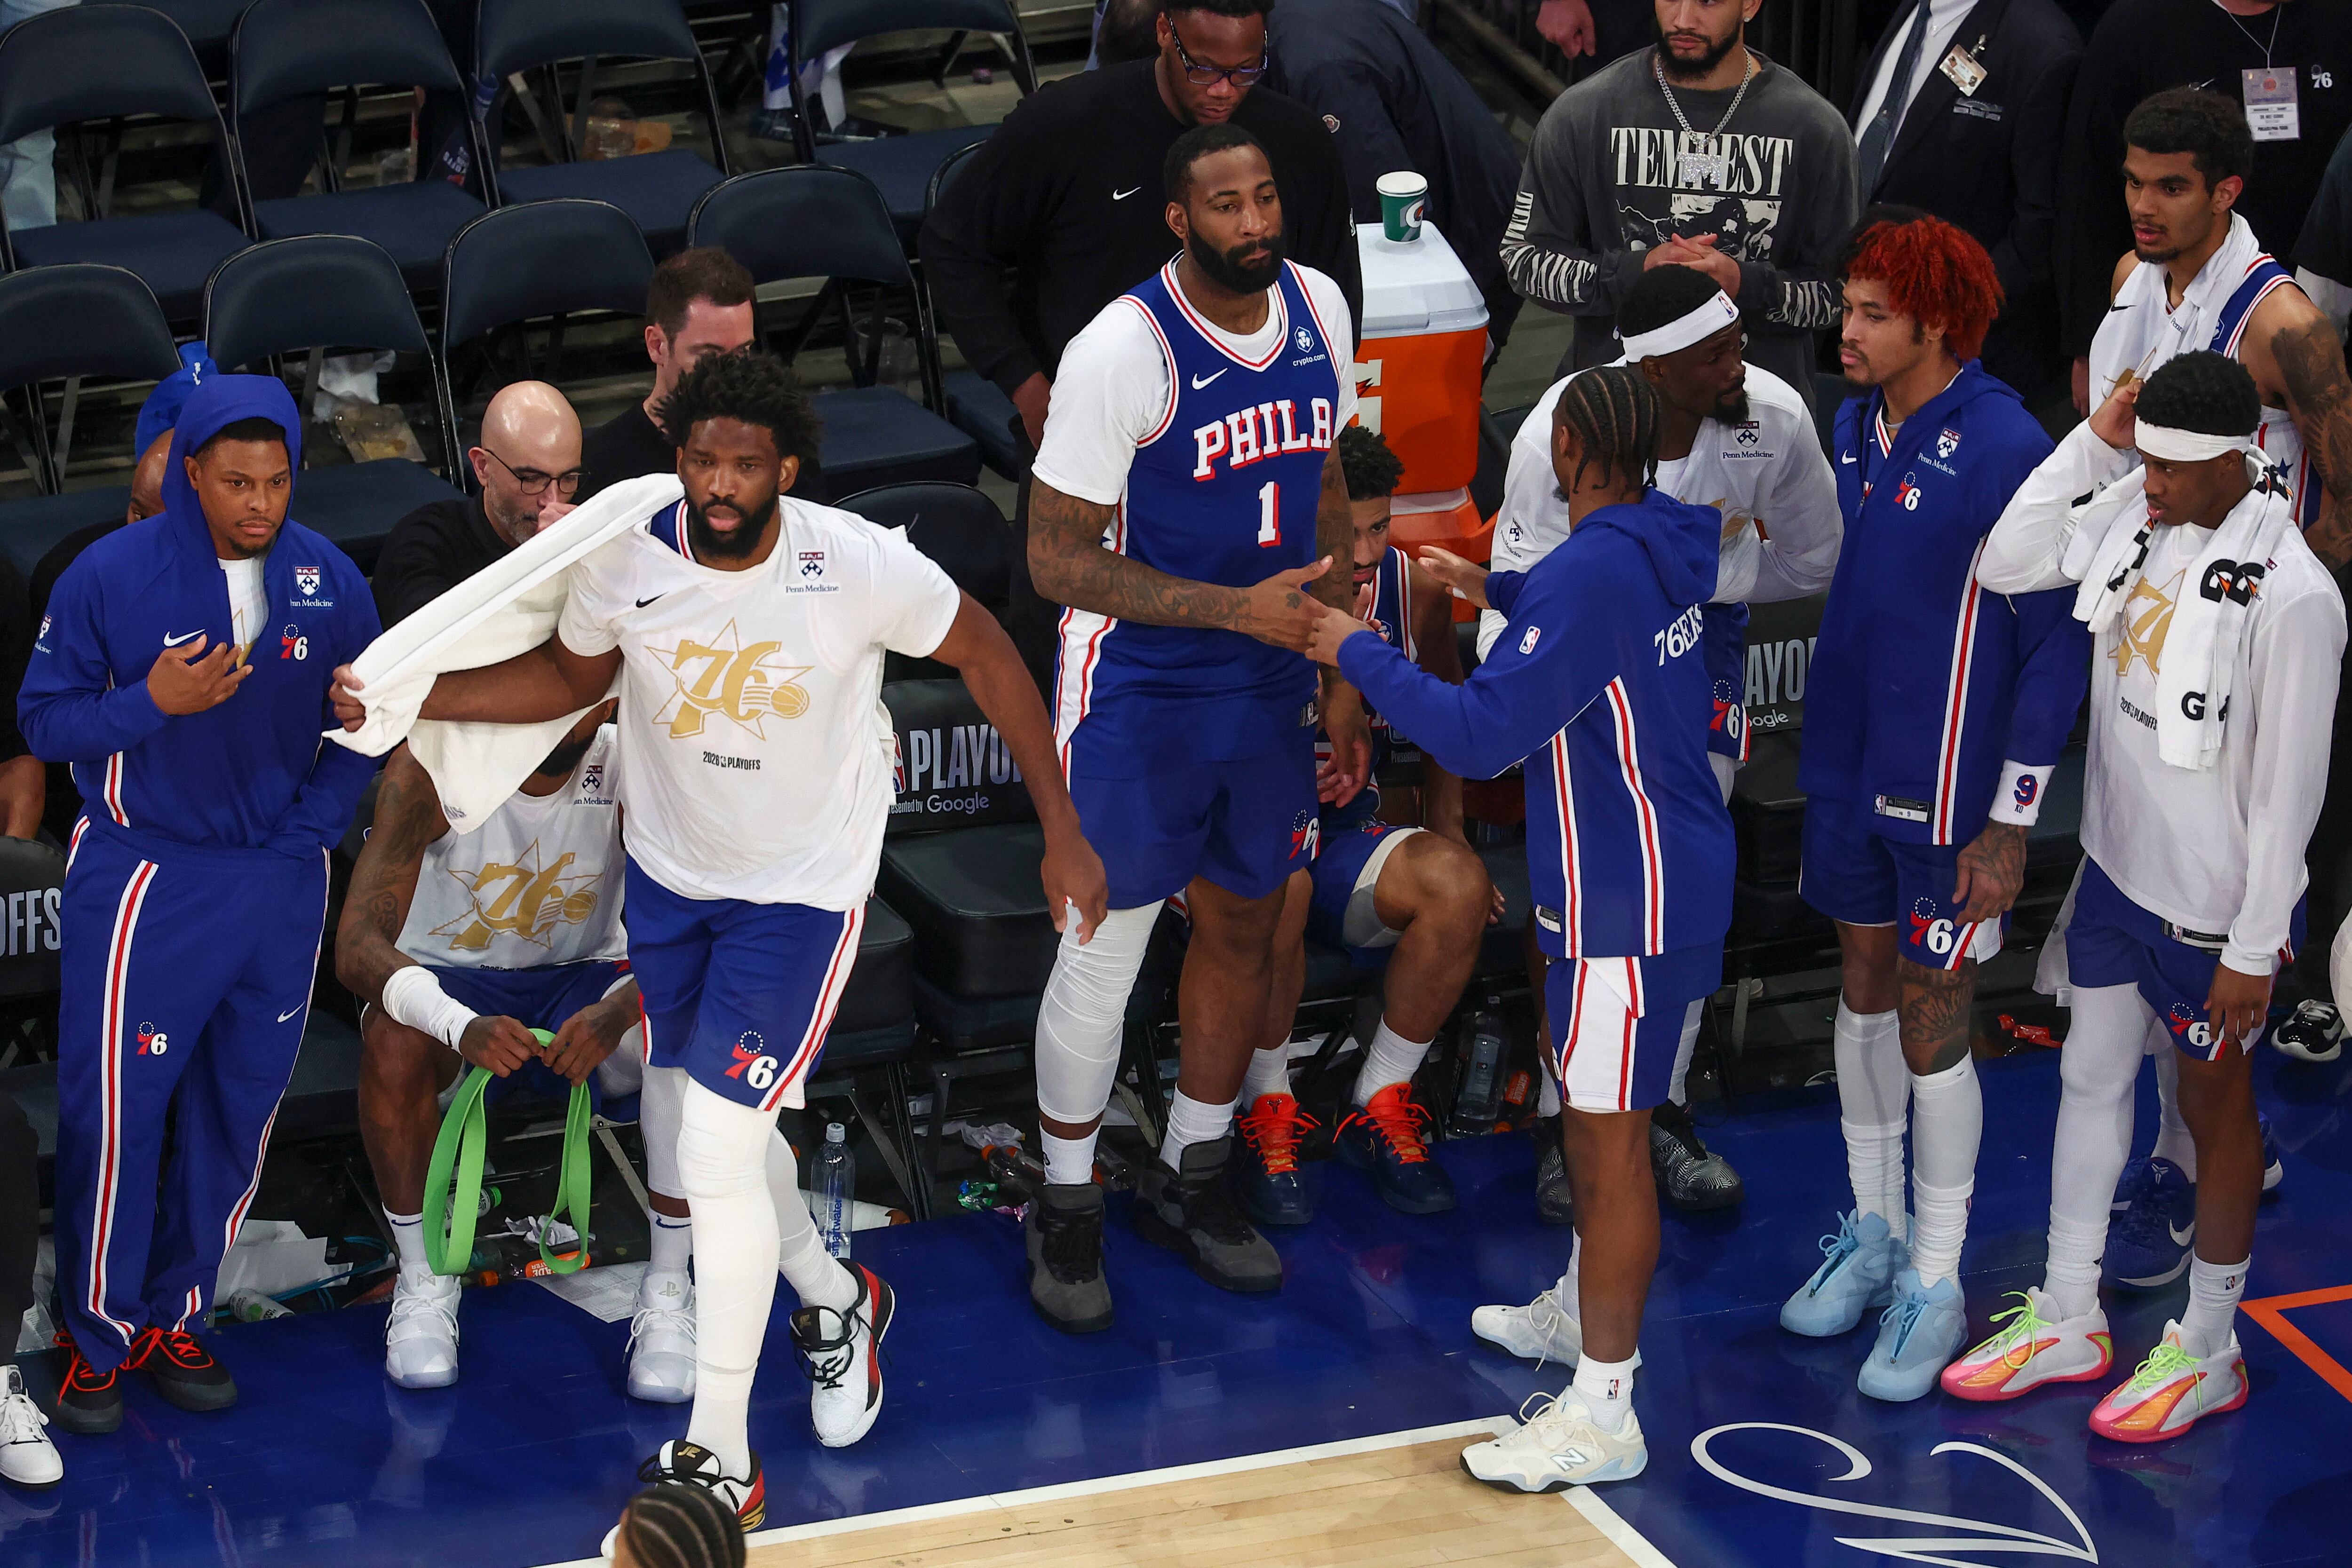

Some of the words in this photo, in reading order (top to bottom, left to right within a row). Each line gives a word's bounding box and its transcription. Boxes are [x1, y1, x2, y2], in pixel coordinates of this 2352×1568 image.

[2311, 72, 2334, 88] 76
[1293, 354, 1326, 366] crypto.com
[1193, 397, 1333, 482] PHILA
[1918, 452, 1932, 465] Penn
[1932, 459, 1957, 476] Medicine
[1894, 480, 1922, 511] 76
[1258, 481, 1281, 548] 1
[302, 598, 334, 607] Medicine
[805, 584, 840, 592] Medicine
[280, 636, 308, 660] 76
[670, 639, 782, 739] 76
[1709, 699, 1740, 739] 76
[703, 751, 720, 768] 2026
[727, 757, 761, 770] PLAYOFFS
[909, 724, 1022, 792] PLAYO
[583, 796, 613, 805] Medicine
[915, 798, 923, 814] by
[927, 792, 989, 815] Google
[2014, 774, 2038, 806] 9
[1288, 817, 1319, 860] 76
[1910, 910, 1954, 954] 76
[137, 1033, 167, 1055] 76
[2169, 1011, 2212, 1047] 76
[724, 1043, 779, 1090] 76
